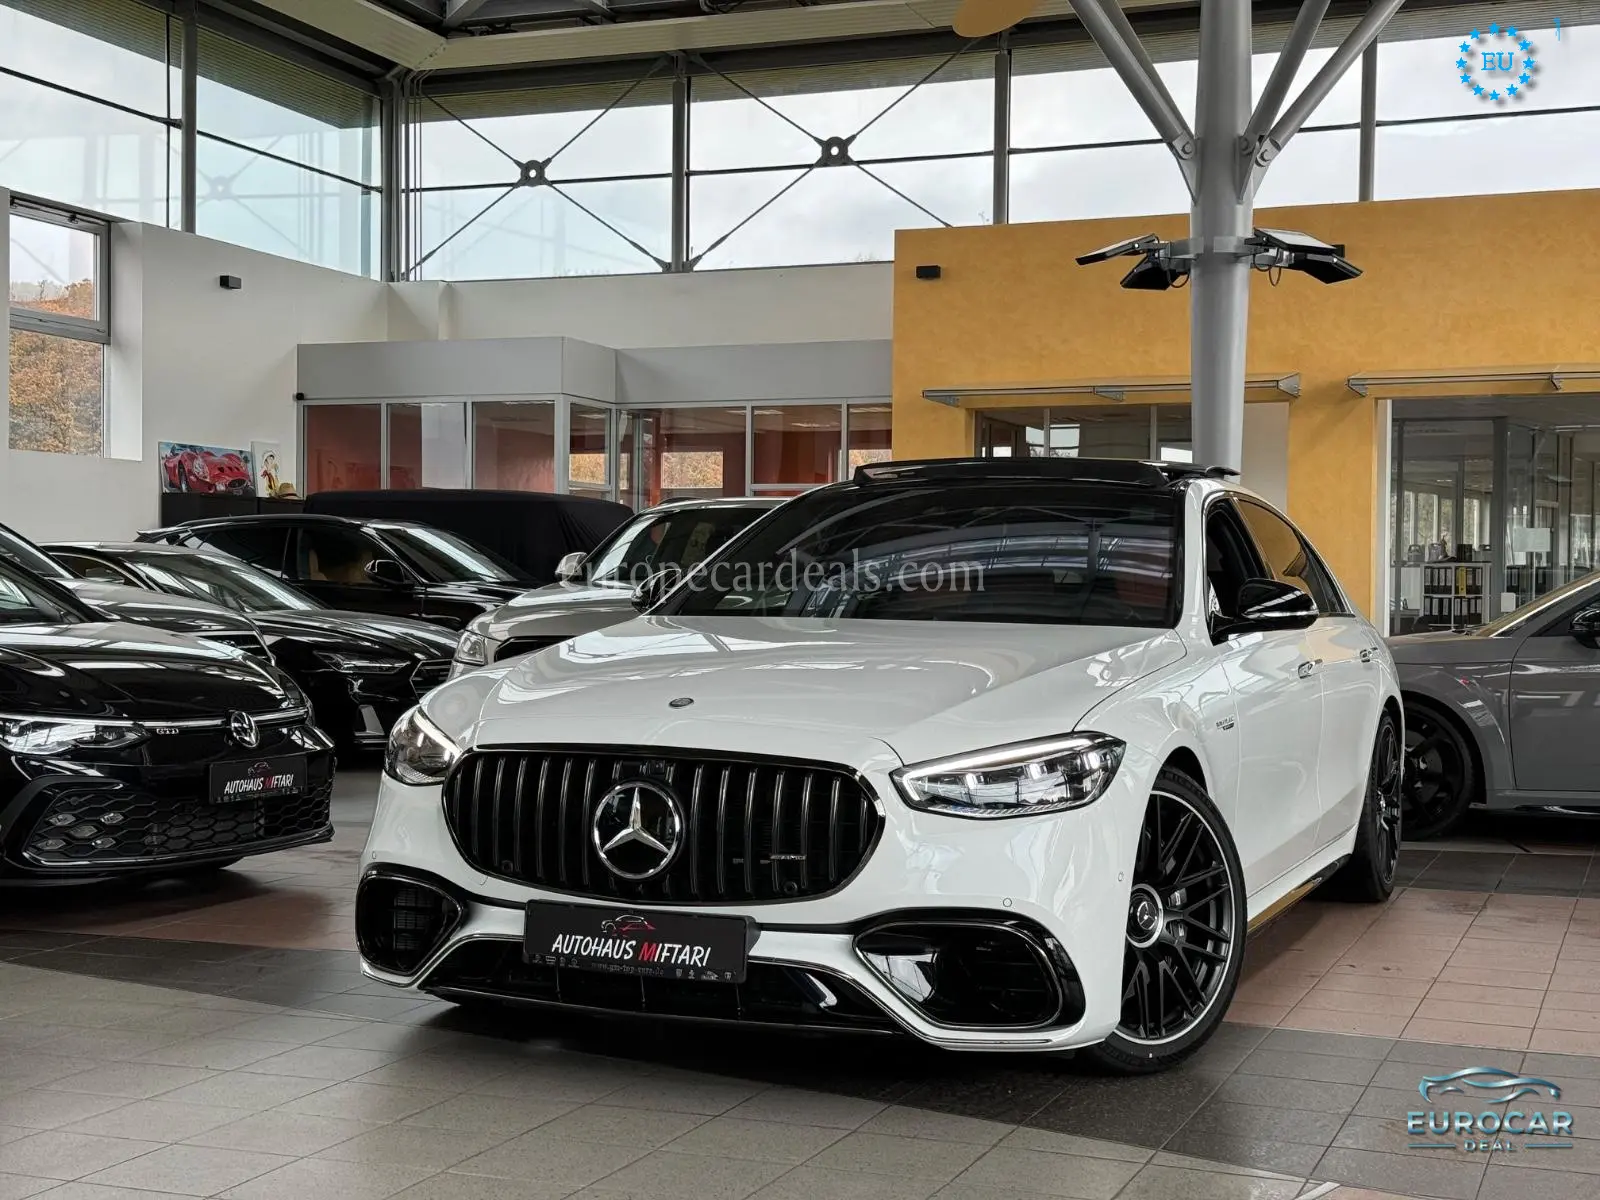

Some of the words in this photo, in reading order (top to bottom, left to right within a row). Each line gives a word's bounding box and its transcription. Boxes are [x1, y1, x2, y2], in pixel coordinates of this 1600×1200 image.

[224, 777, 264, 794] AUTOHAUS
[264, 774, 294, 789] MIFTARI
[551, 933, 637, 960] AUTOHAUS
[638, 942, 711, 967] MIFTARI
